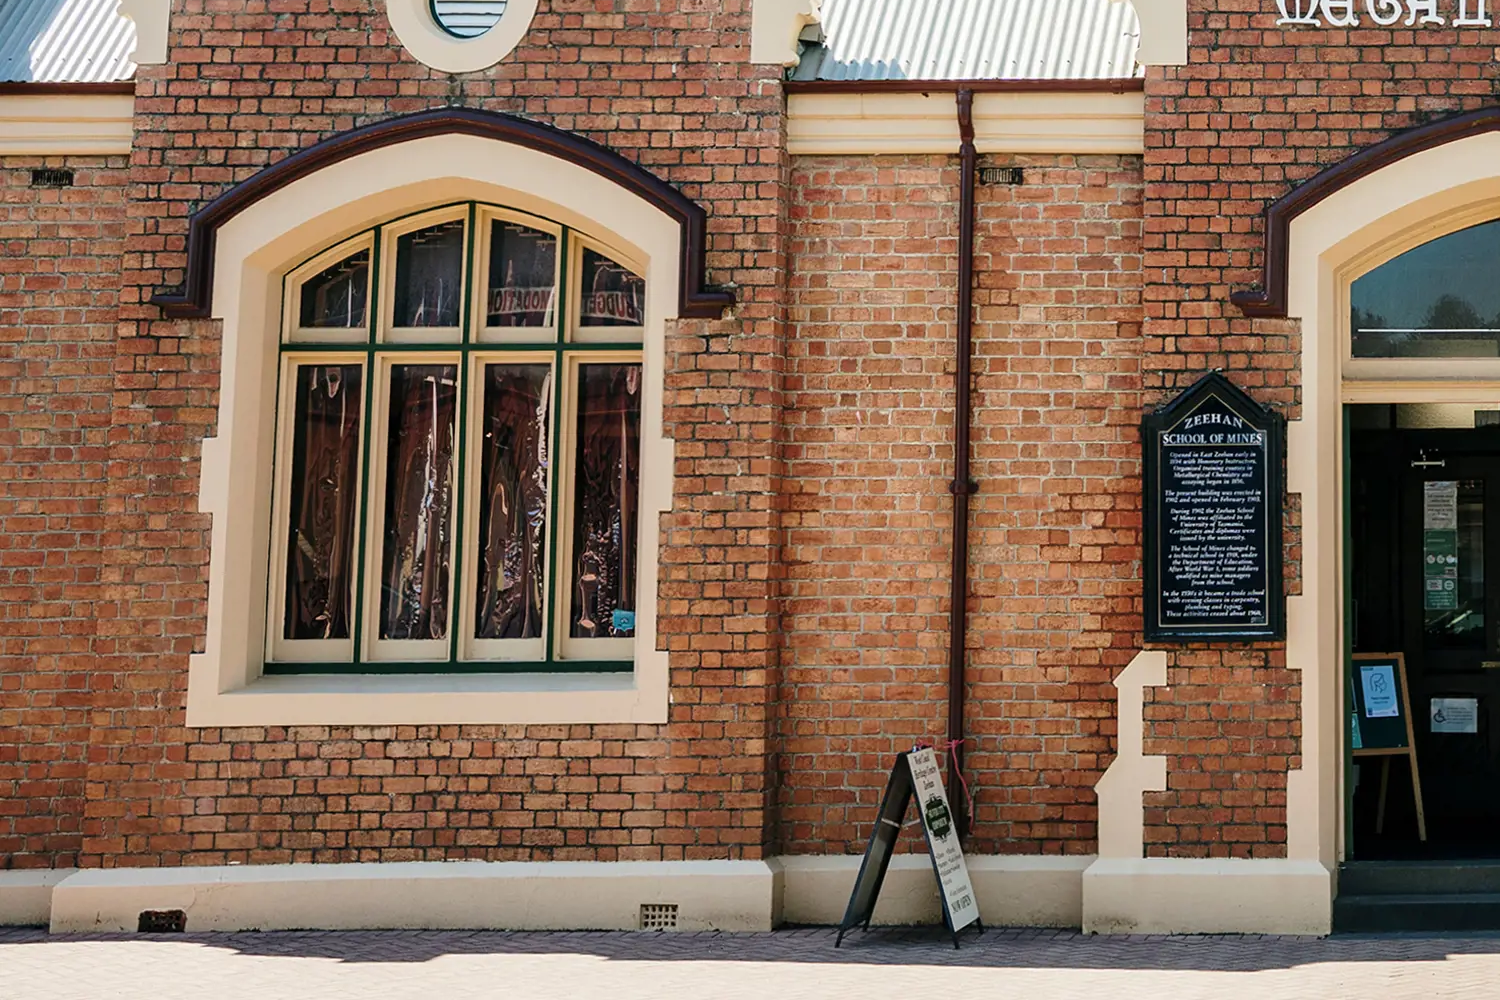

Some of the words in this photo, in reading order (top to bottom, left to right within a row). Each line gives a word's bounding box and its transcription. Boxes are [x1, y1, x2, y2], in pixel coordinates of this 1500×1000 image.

[1184, 413, 1243, 430] ZEEHAN
[1163, 433, 1208, 444] SCHOOL
[1209, 433, 1224, 444] OF
[1226, 433, 1262, 444] MINES
